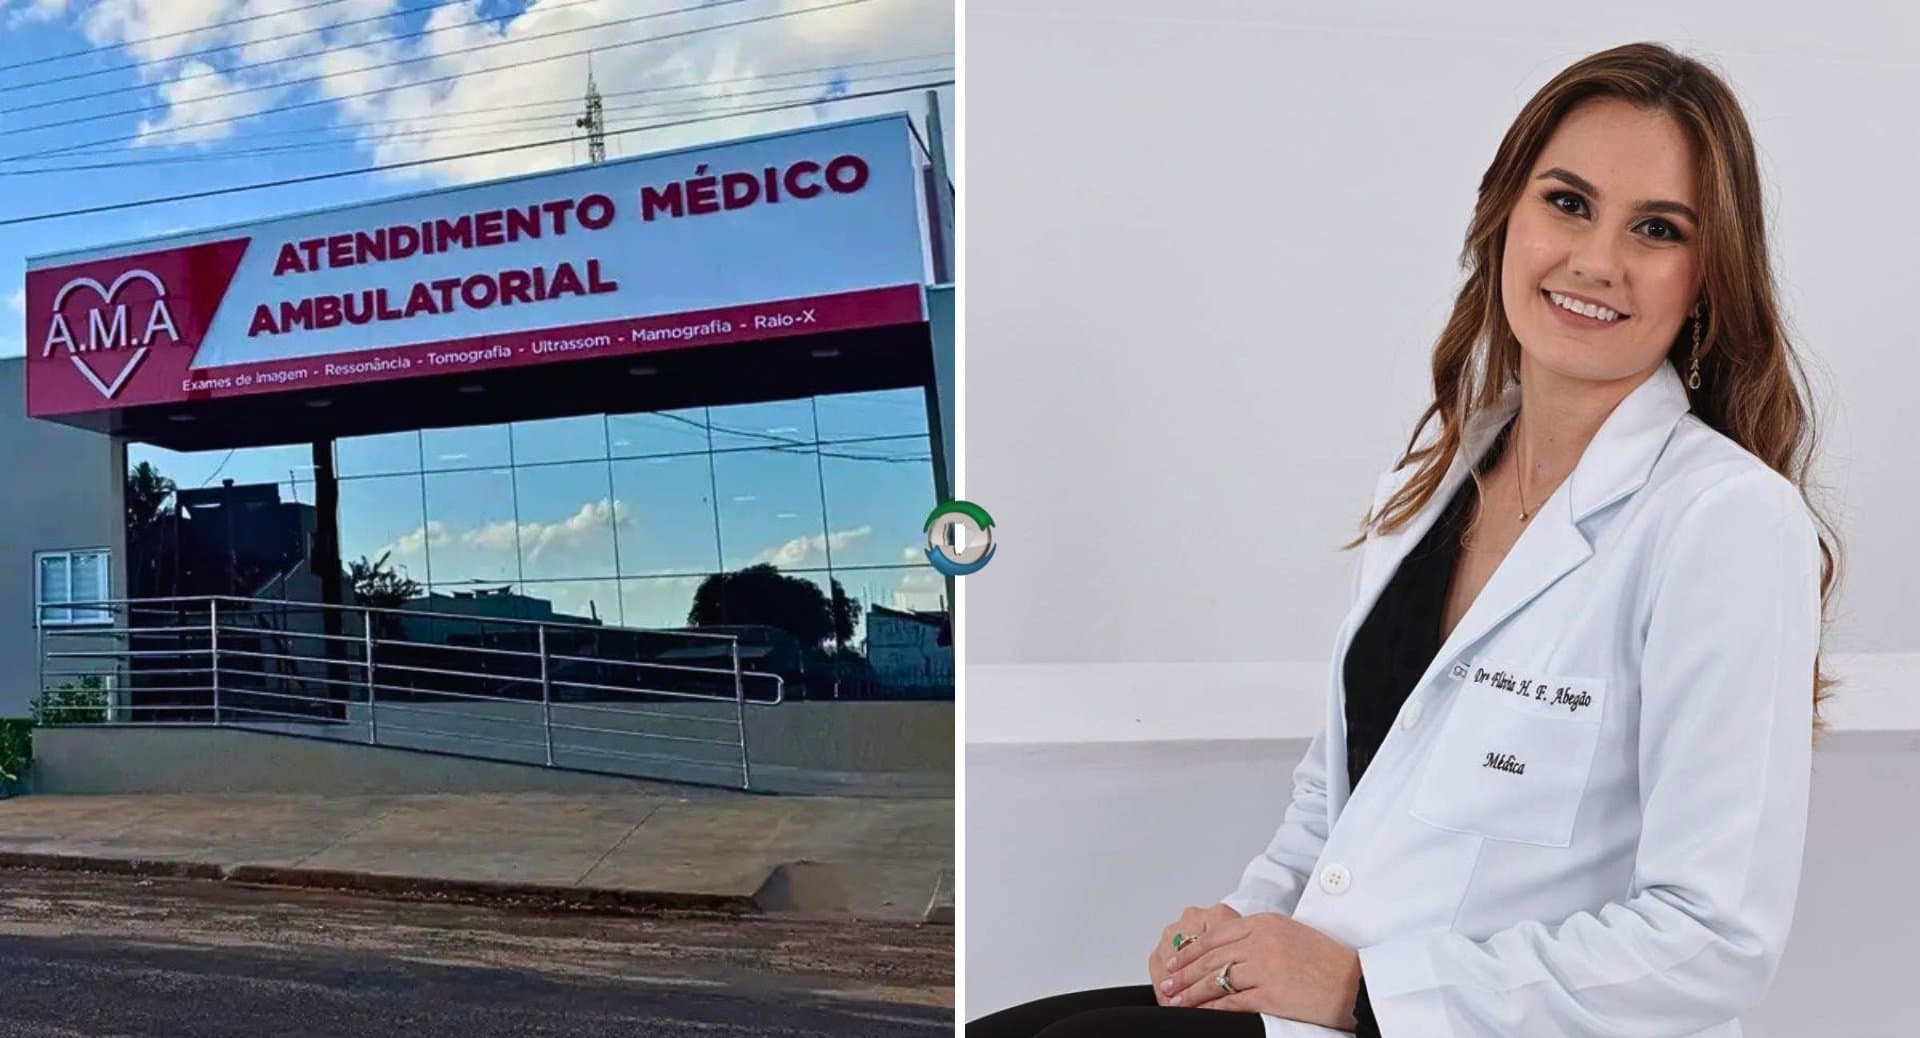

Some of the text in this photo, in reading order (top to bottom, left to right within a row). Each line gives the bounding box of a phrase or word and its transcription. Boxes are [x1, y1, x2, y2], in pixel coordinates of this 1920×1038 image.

[273, 154, 870, 277] ATENDIMENTO MÉDICO
[42, 299, 181, 359] A.M.A
[248, 258, 618, 338] AMBULATORIAL
[182, 377, 232, 392] Exames
[235, 373, 252, 387] de
[324, 357, 411, 376] Ressonância
[427, 345, 512, 365] Tomografia
[531, 333, 610, 354] Ultrassom
[631, 320, 732, 342] Mamografia
[754, 308, 816, 329] Raio-X
[1536, 685, 1547, 701] F.
[1482, 751, 1526, 775] Médica
